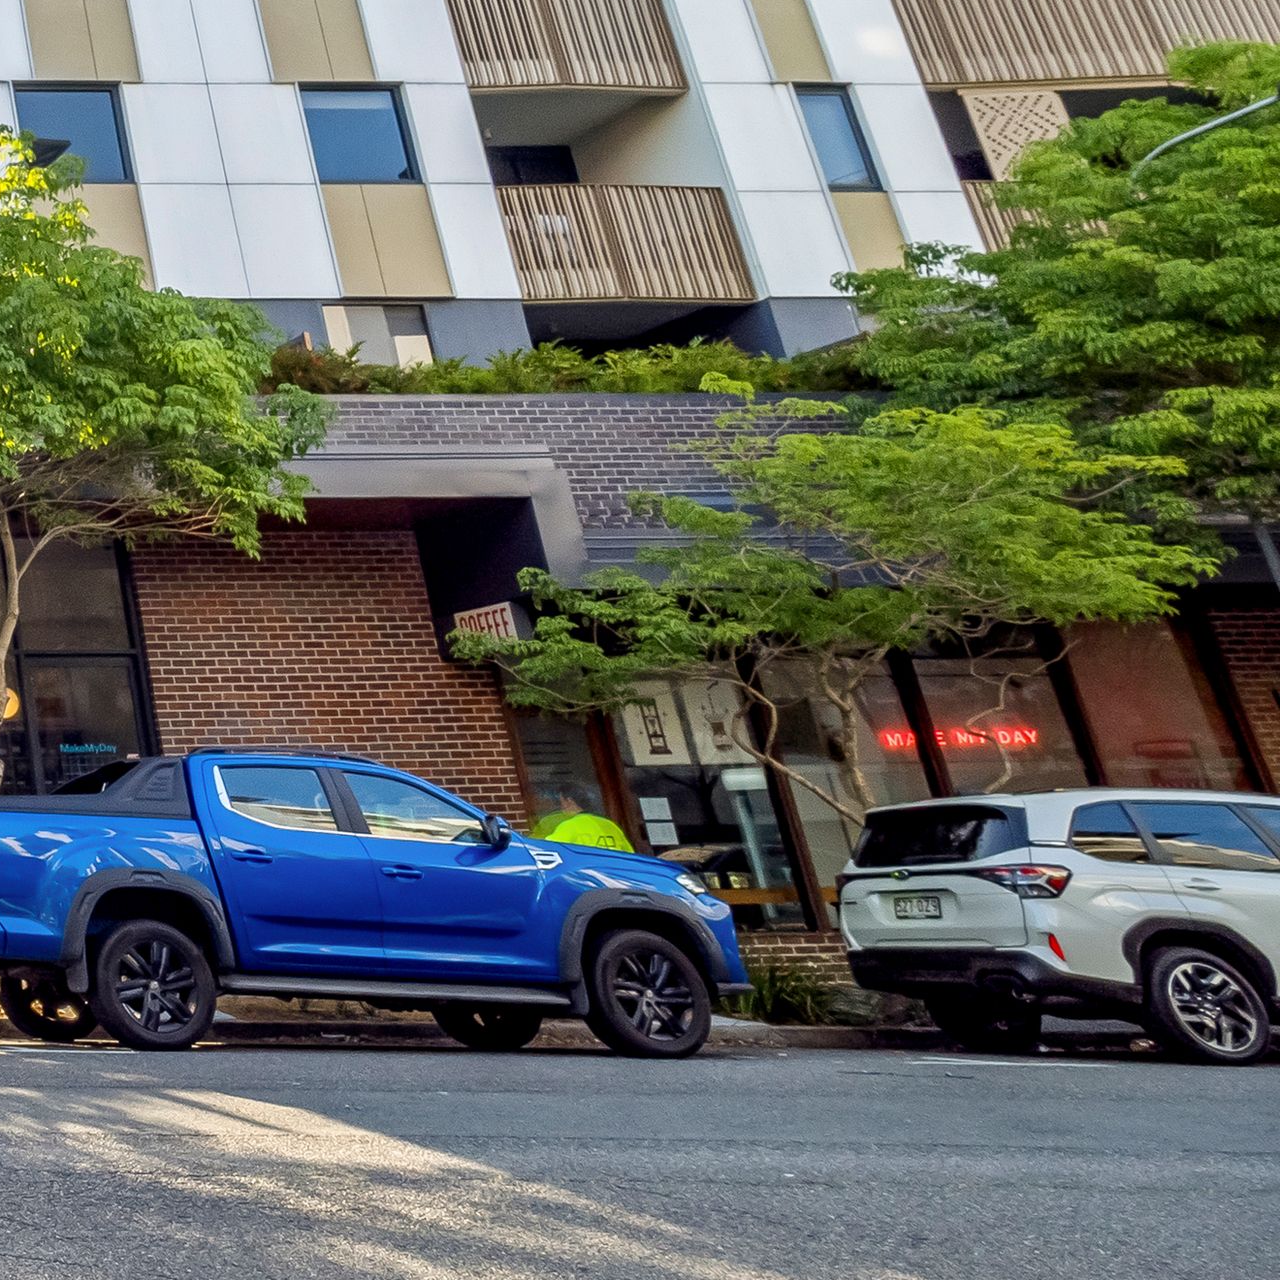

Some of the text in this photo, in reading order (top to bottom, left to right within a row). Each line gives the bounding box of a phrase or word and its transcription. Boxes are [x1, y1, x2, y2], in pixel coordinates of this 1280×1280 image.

[886, 731, 947, 747] MAE
[997, 730, 1037, 745] DAY
[59, 743, 117, 754] MakeMyDay
